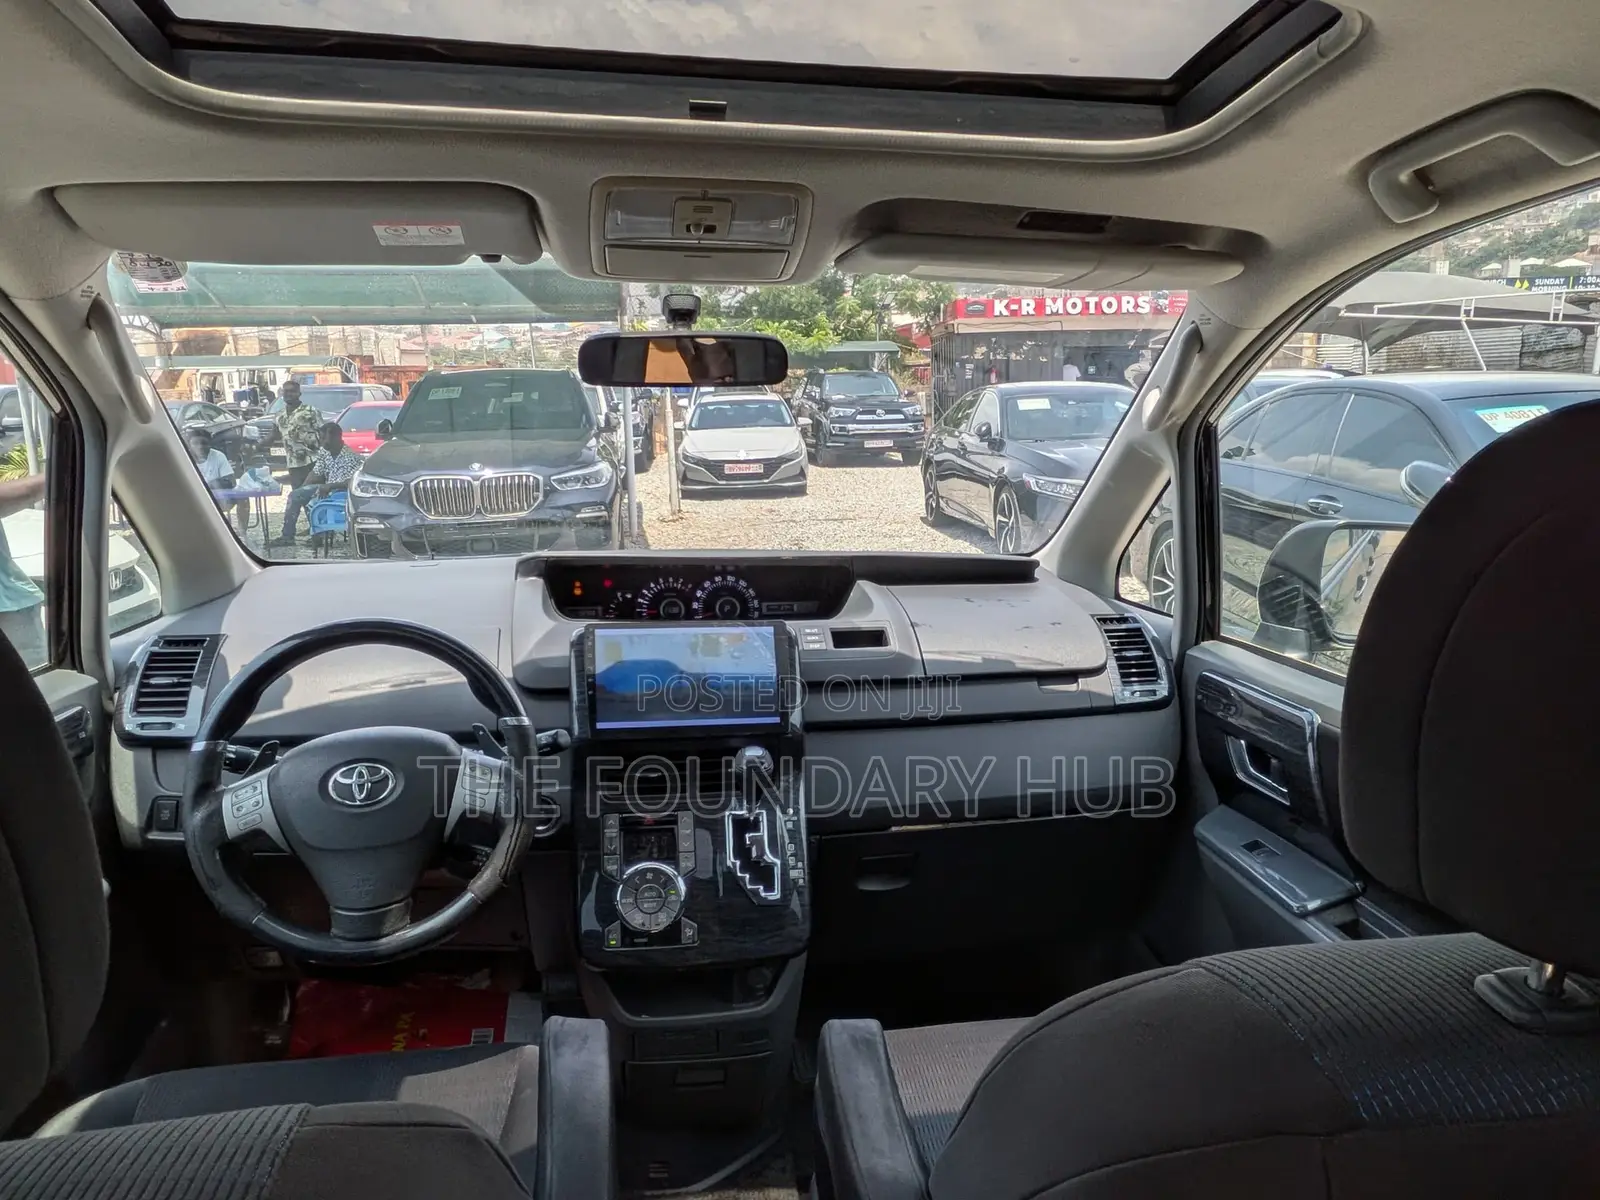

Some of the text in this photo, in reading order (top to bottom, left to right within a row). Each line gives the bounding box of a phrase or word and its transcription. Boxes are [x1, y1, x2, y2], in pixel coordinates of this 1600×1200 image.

[1535, 278, 1566, 286] SUNDAY
[1531, 285, 1567, 293] MORNING
[993, 298, 1036, 317] K-R
[1045, 295, 1151, 315] MOTORS
